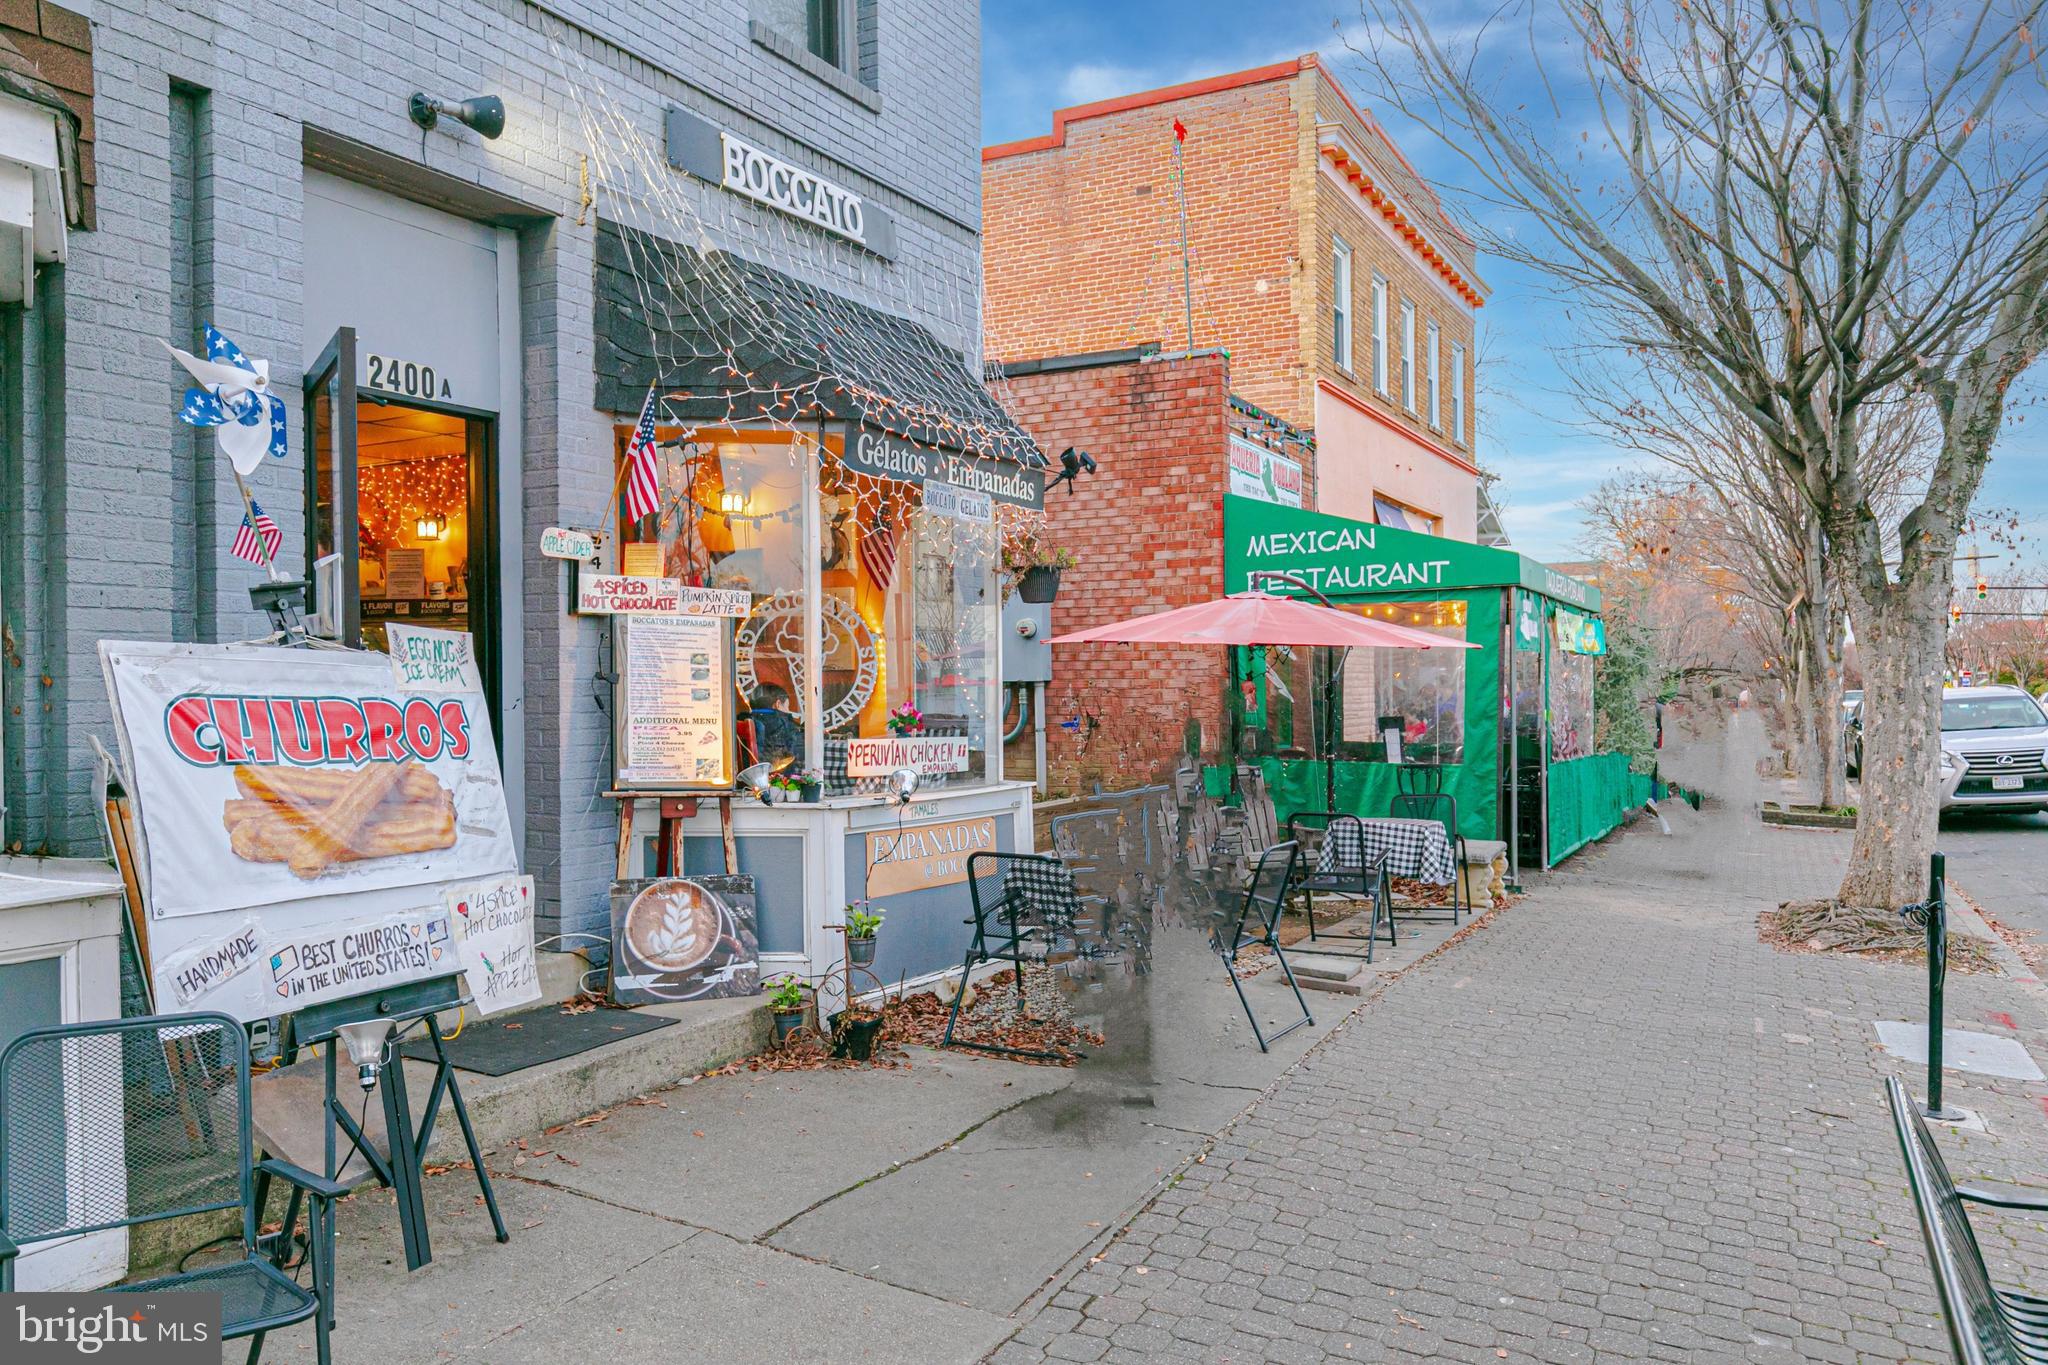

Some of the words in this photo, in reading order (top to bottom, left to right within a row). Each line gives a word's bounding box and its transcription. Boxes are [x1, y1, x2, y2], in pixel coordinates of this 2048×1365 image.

[721, 132, 866, 244] BOCCATO
[369, 355, 434, 398] 2400
[441, 378, 452, 399] A
[947, 454, 1035, 502] Empanadas
[926, 490, 956, 511] BOCCATO
[960, 499, 989, 519] GELATOS
[543, 535, 564, 553] APPLE
[1246, 528, 1376, 557] MEXICAN
[581, 593, 609, 610] HOT
[610, 595, 677, 611] CHOCOLATE
[702, 604, 736, 614] LATTE
[407, 637, 432, 661] EGG
[402, 662, 425, 684] ICE
[427, 662, 467, 687] CREAM
[164, 692, 471, 769] CHURROS
[633, 717, 690, 725] ADDITIONAL
[855, 740, 908, 767] PERUVIAN
[910, 740, 954, 764] CHICKEN
[910, 803, 939, 818] TAMALES
[873, 821, 992, 864] EMPANADAS
[464, 916, 486, 940] HOT
[302, 940, 337, 971] BEST
[342, 923, 410, 959] CHURROS
[176, 928, 258, 996] HANDMADE
[309, 972, 329, 992] THE
[484, 968, 519, 998] APPLE
